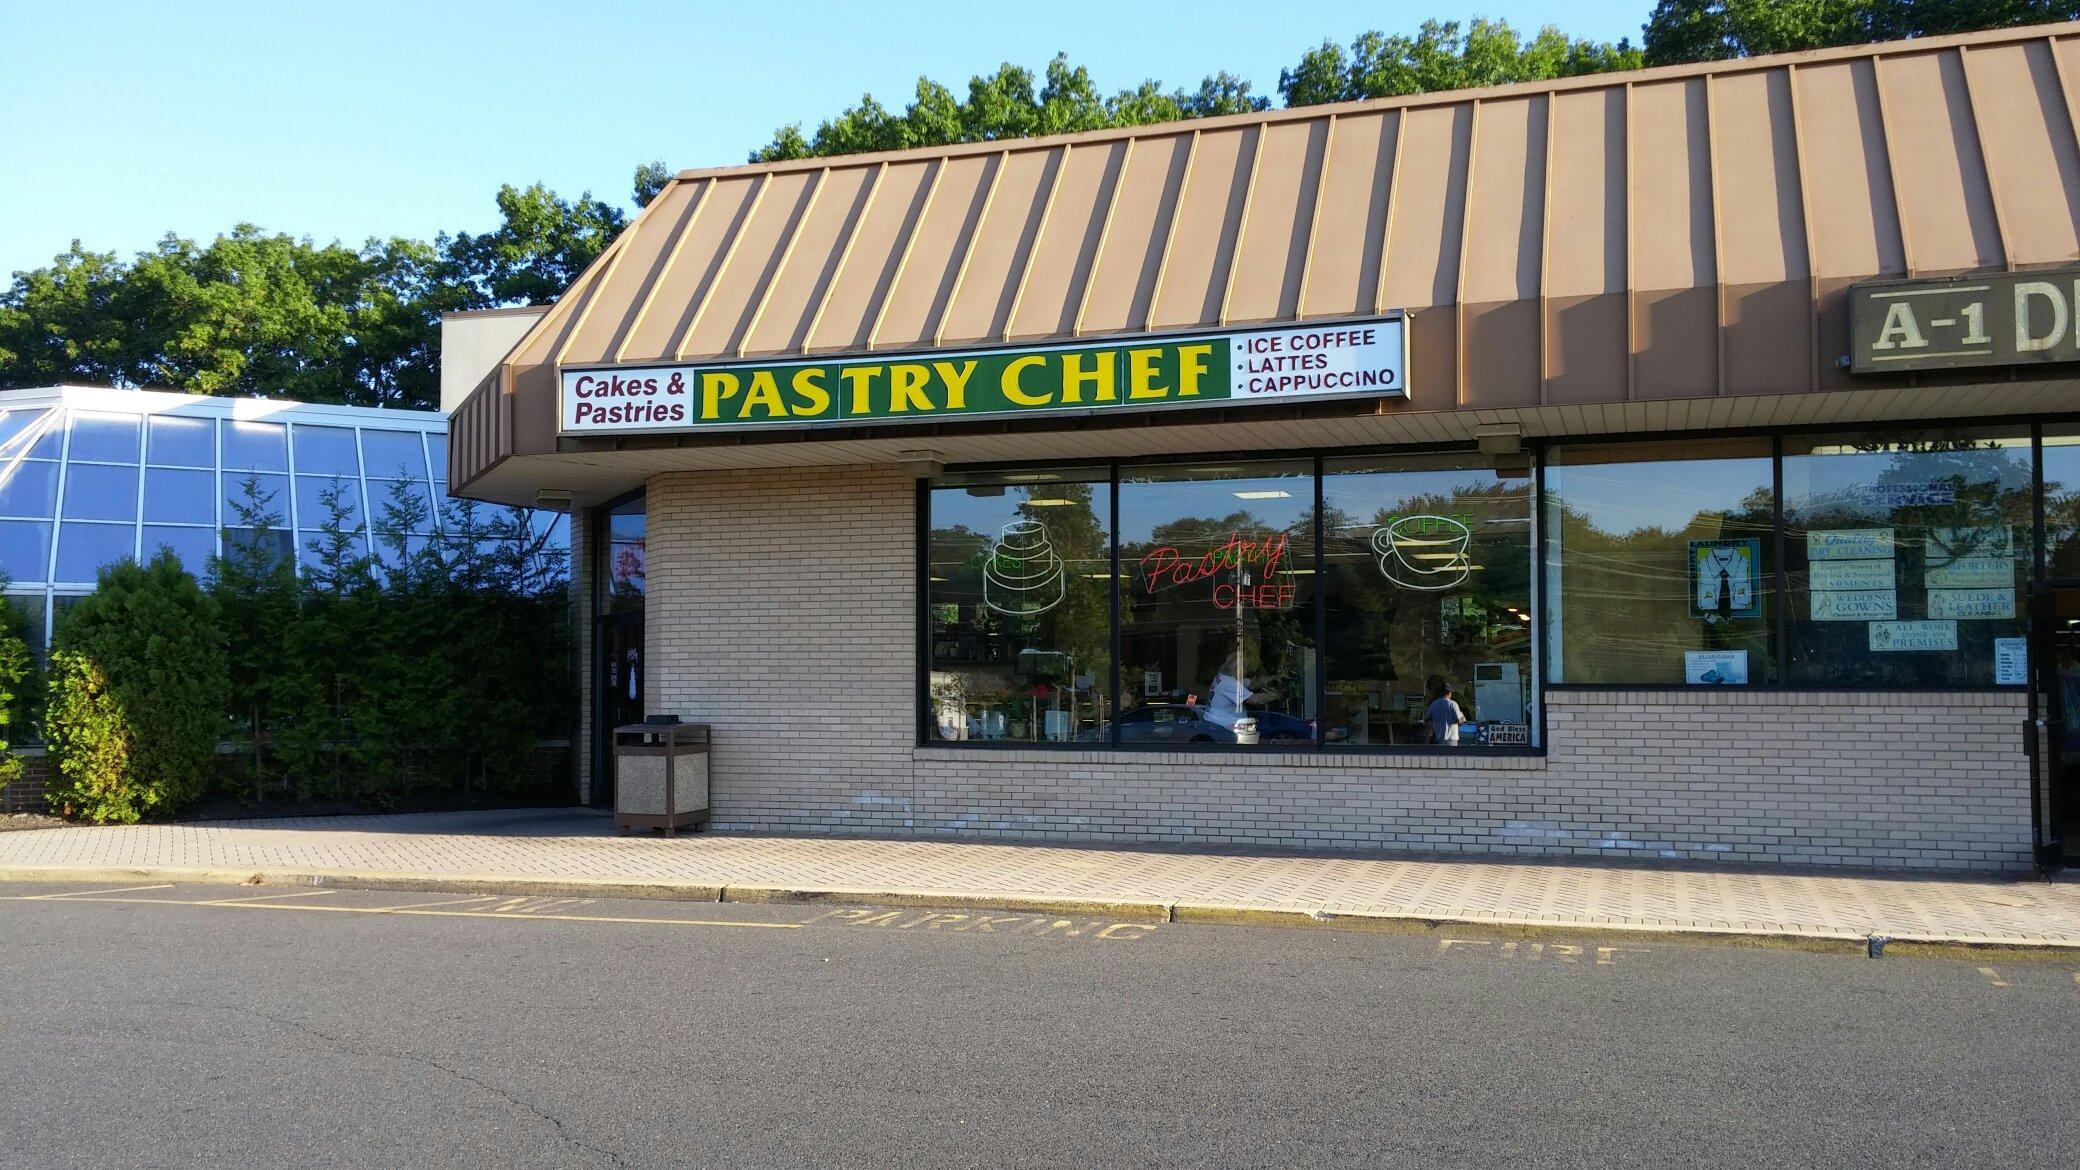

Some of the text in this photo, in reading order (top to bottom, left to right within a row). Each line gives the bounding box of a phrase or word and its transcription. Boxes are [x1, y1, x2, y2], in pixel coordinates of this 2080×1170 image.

[1872, 278, 2080, 352] A-1 D
[1248, 329, 1376, 354] ICE COFFEE
[1248, 354, 1328, 374] LATTES
[575, 372, 686, 398] Cakes &
[701, 344, 1213, 419] PASTRY CHEF
[1248, 369, 1395, 394] CAPPUCCINO
[575, 400, 685, 424] Pastries
[1388, 513, 1476, 534] COFFEE
[1838, 545, 1892, 556] CLEANING
[1140, 533, 1288, 593] Pastry
[1213, 584, 1296, 609] CHEF
[1836, 593, 1891, 602] WEDDING
[1948, 602, 2011, 611] LEATHER
[1951, 592, 1992, 602] SUEDE
[1836, 602, 1894, 612] GOWNS
[1896, 623, 1952, 632] ALL WORK
[1893, 639, 1955, 648] PREMISES
[1490, 733, 1526, 742] AMERICA
